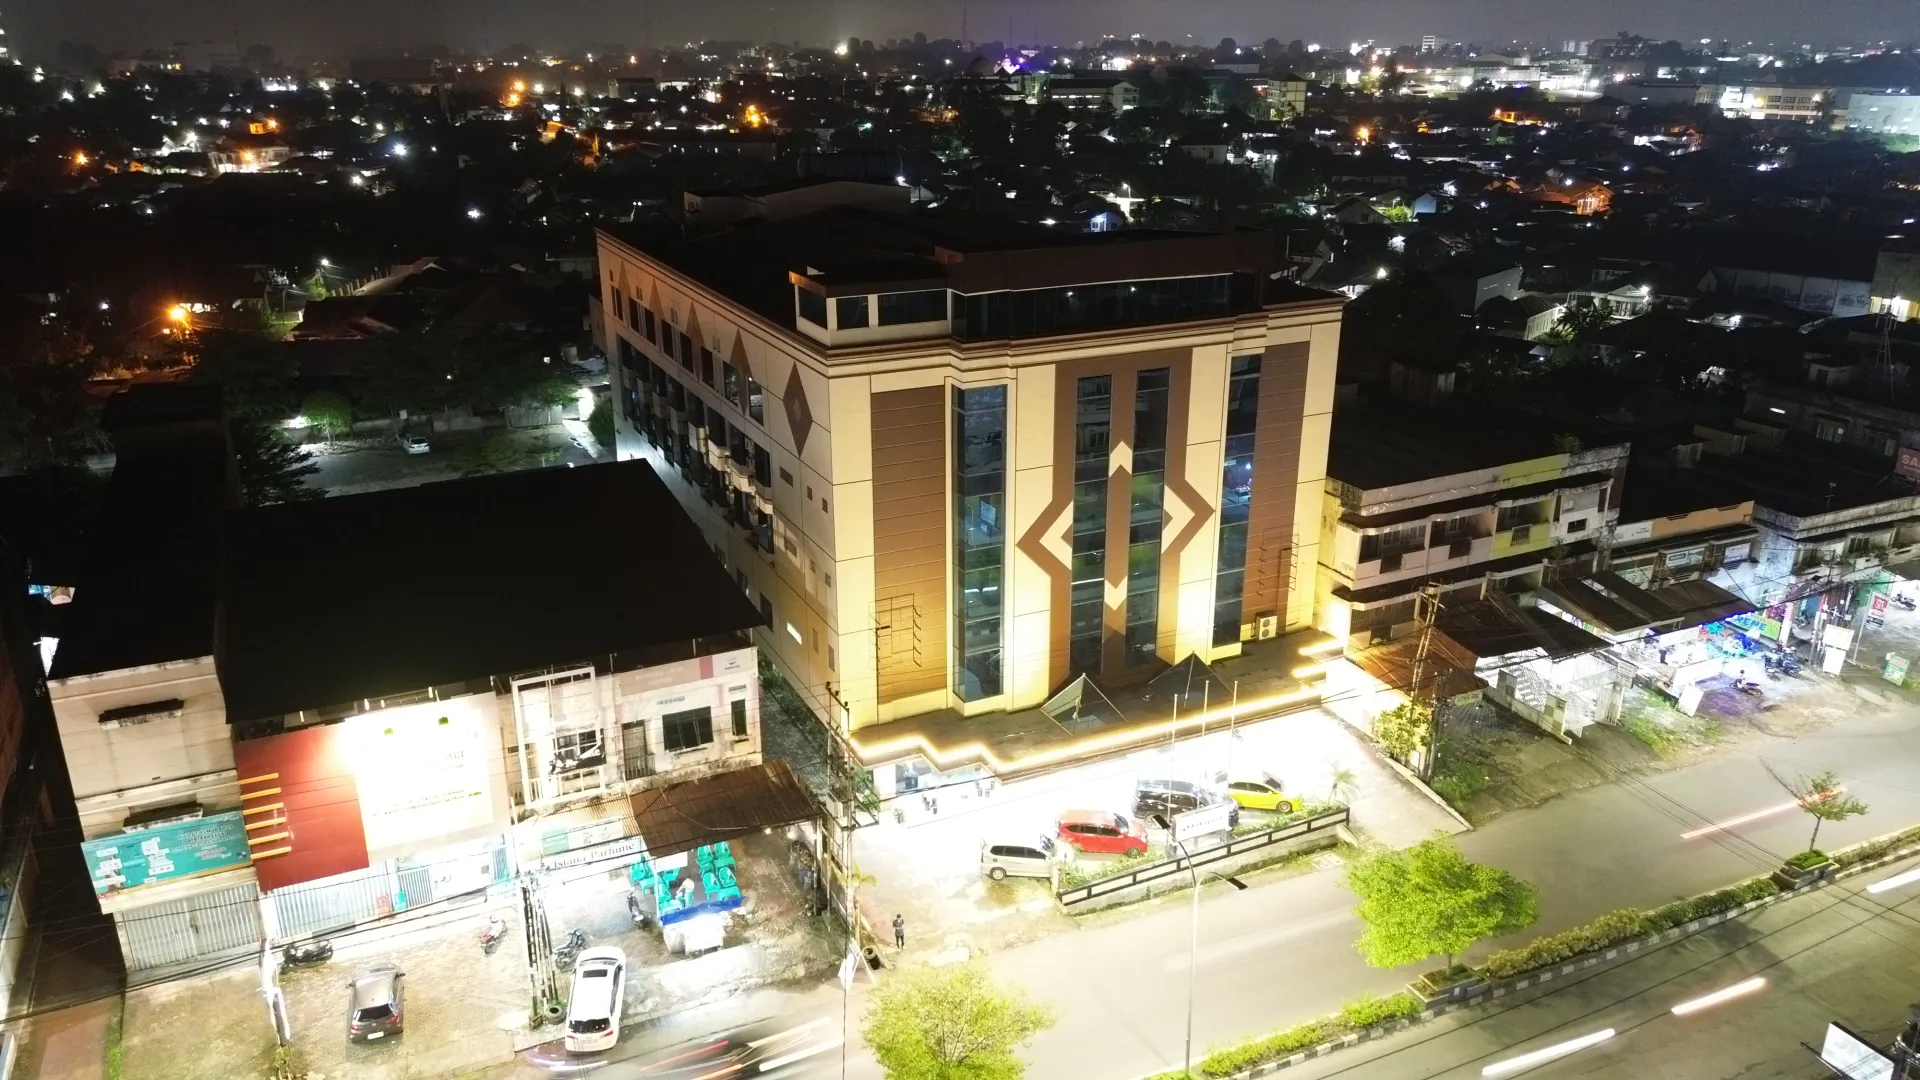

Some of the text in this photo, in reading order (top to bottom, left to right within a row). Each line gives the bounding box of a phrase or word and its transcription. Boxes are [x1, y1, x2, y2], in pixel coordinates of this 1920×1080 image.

[1901, 454, 1920, 469] SA
[554, 843, 635, 869] Istana Parfume
